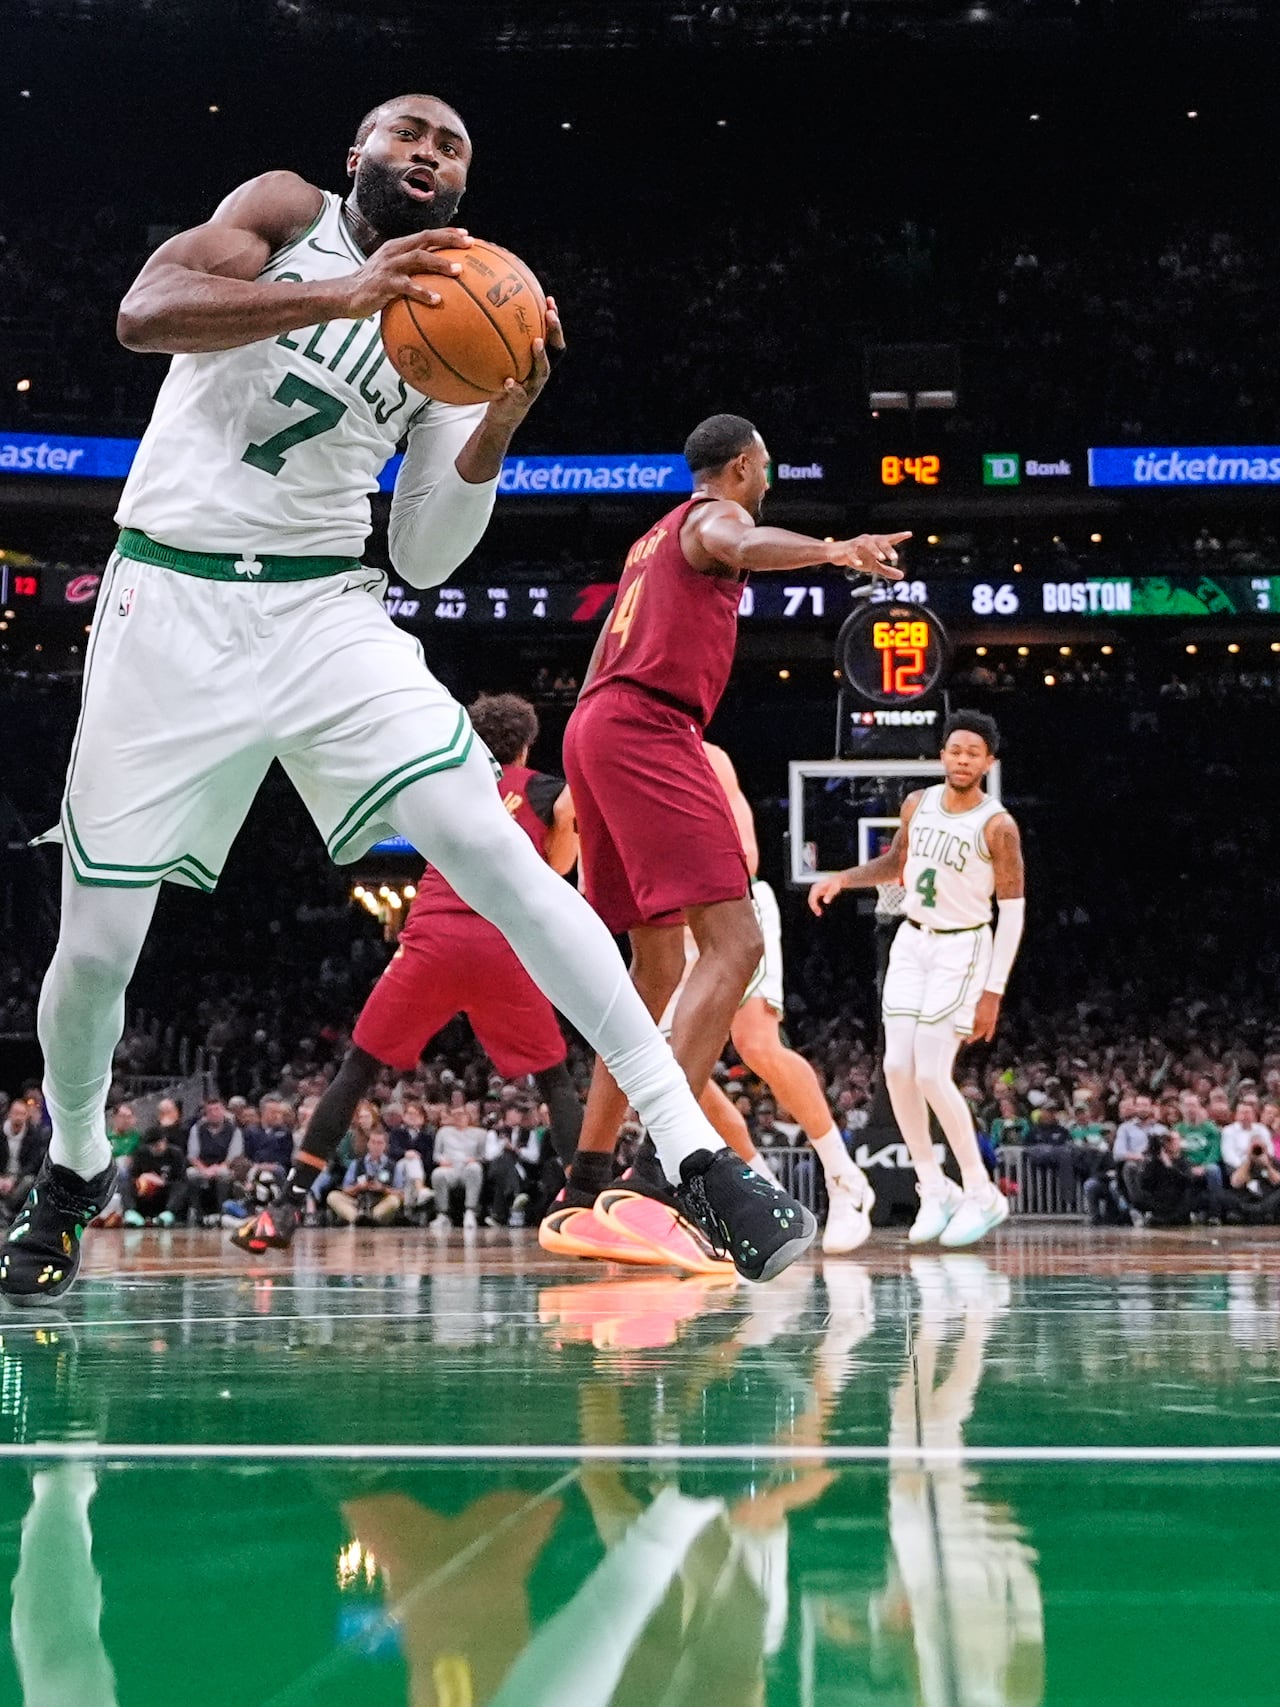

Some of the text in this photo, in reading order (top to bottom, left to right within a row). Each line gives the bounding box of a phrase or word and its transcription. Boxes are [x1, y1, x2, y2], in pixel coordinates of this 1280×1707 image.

[241, 372, 349, 477] 7
[778, 464, 822, 479] Bank
[881, 455, 940, 485] 8:42
[987, 458, 1071, 478] TD Bank
[533, 601, 547, 618] 4
[609, 572, 647, 649] 4
[783, 586, 825, 617] 71
[971, 583, 1020, 615] 86
[1042, 582, 1132, 612] BOSTON
[873, 621, 929, 649] 6:28
[882, 648, 926, 695] 12
[874, 710, 937, 726] TISSOT
[911, 826, 971, 873] CELTICS
[915, 867, 938, 909] 4
